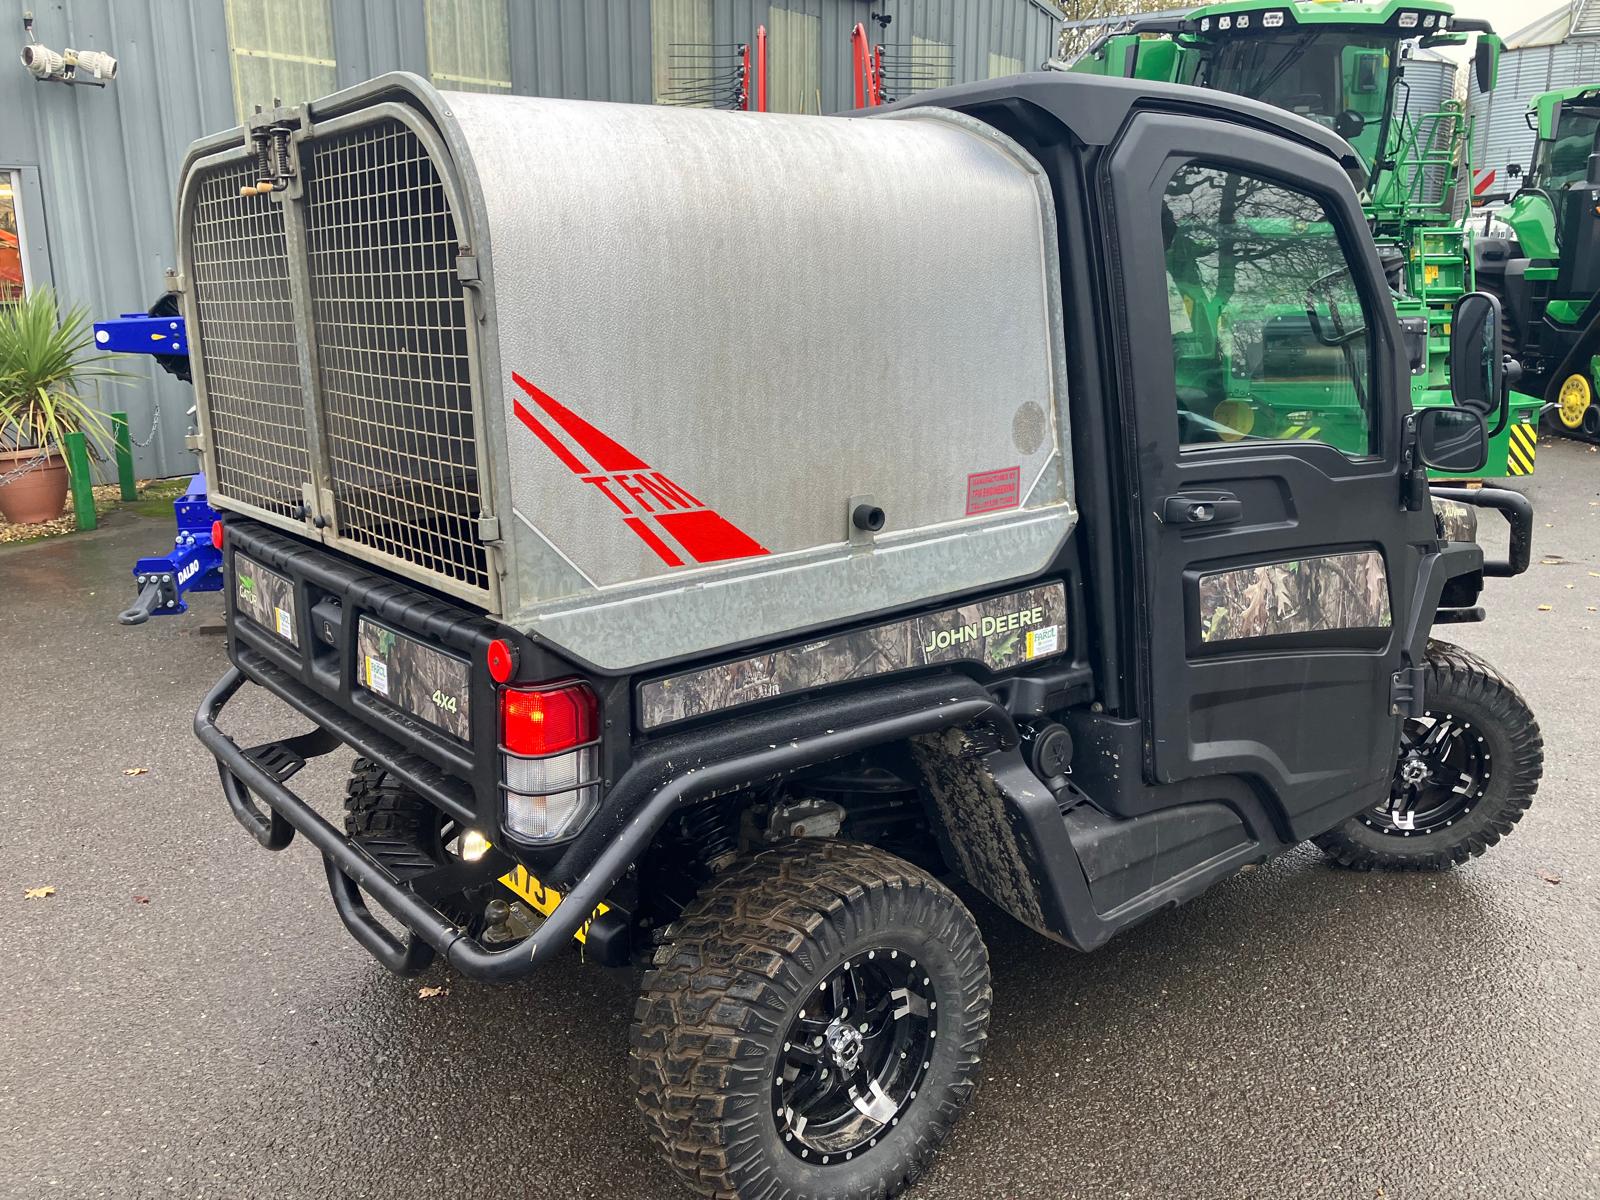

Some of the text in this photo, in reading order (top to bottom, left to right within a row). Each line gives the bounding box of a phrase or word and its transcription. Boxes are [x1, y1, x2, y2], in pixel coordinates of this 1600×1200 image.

[580, 472, 705, 514] TFM
[178, 559, 199, 585] DALBO
[240, 584, 257, 604] GATOR
[925, 607, 1043, 652] JOHN DEERE
